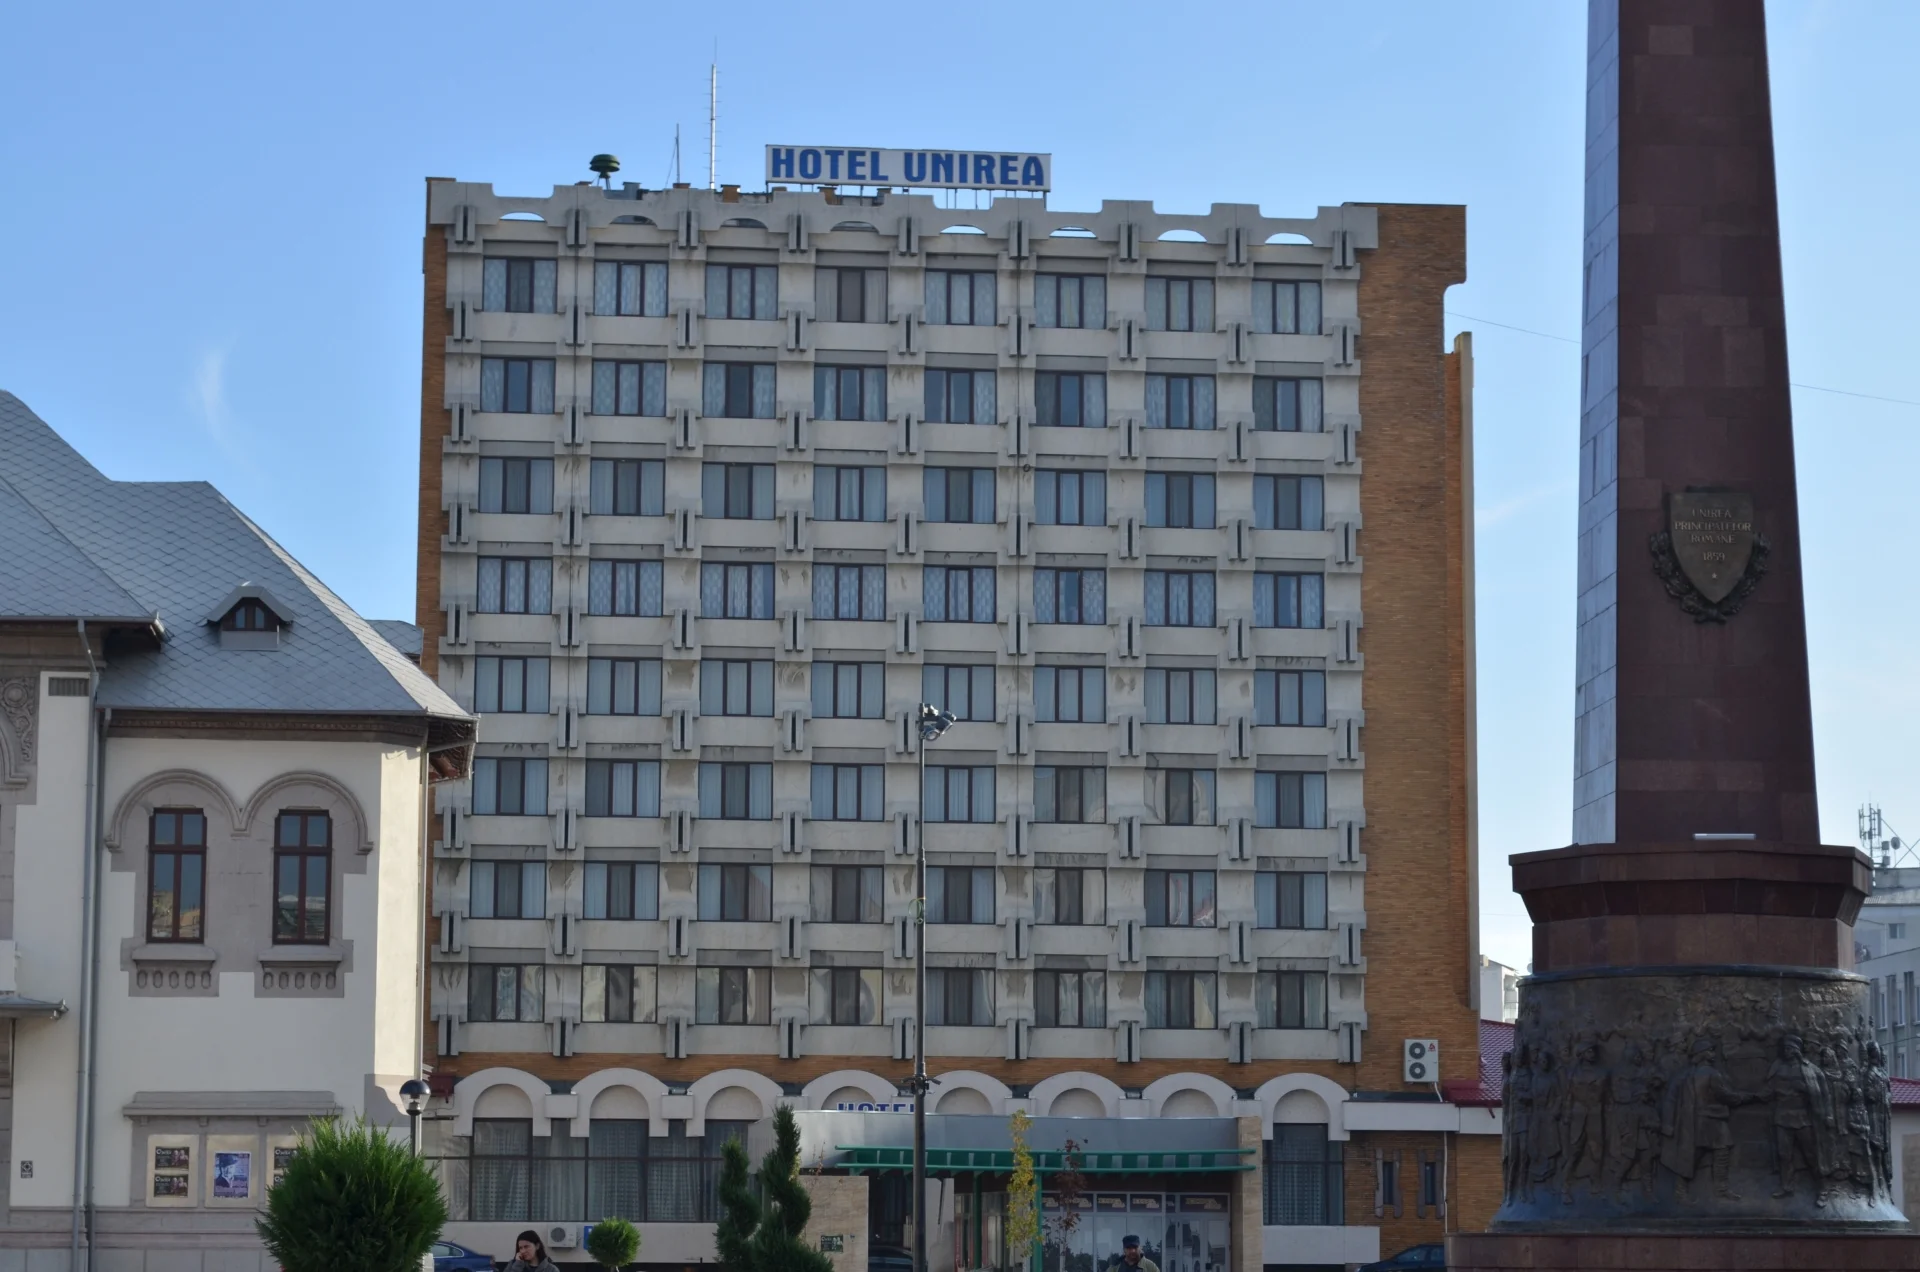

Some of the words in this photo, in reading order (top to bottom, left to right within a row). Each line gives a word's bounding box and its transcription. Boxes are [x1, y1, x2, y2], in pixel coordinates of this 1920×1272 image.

[772, 148, 888, 181] HOTEL
[903, 153, 1043, 186] UNIREA
[1692, 508, 1732, 518] UNIREA
[1703, 551, 1725, 561] 1859
